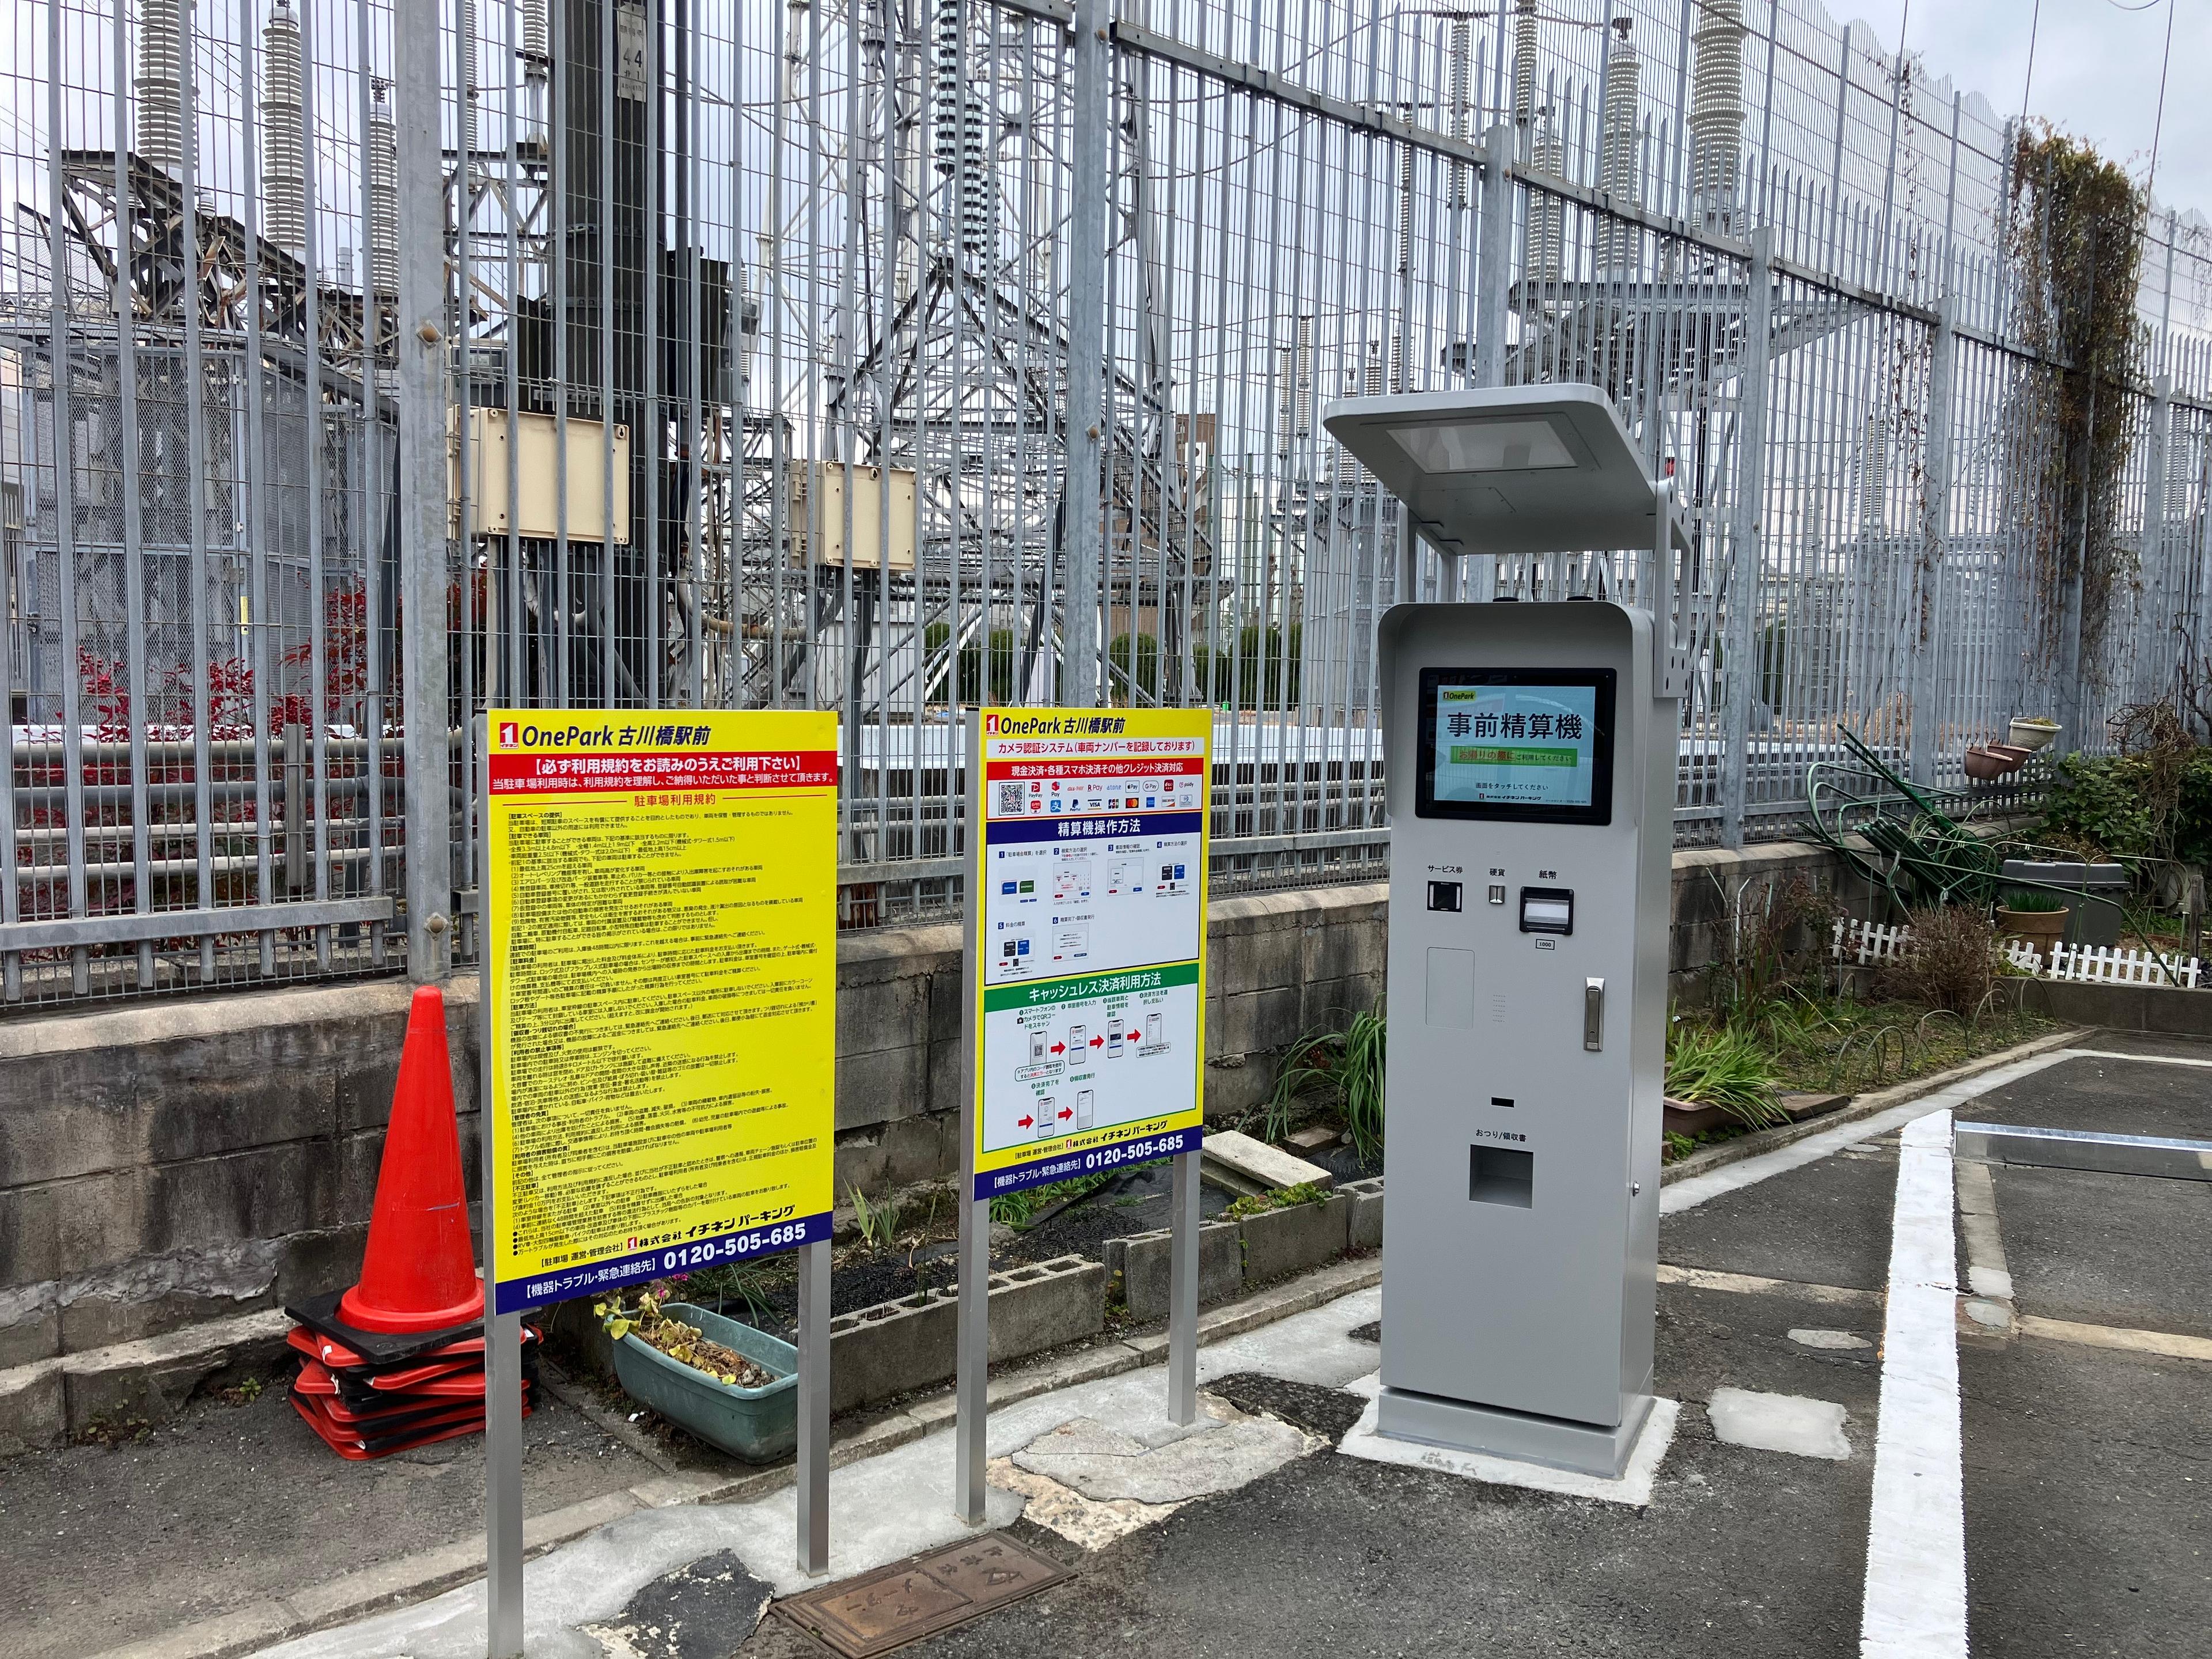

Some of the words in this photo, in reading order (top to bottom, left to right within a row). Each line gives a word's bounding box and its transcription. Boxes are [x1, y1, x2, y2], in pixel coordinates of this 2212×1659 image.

[1001, 717, 1060, 734] OnePark
[1063, 717, 1126, 734] 古川橋駅前
[1447, 712, 1582, 740] 事前精算機
[522, 725, 615, 747] OnePark
[618, 725, 711, 747] 古川橋駅前
[998, 740, 1195, 755] カメラ認証システム(車両ナンバーを記録しております)
[535, 756, 802, 775] 【必ず利用規約をお読みのうえご利用下さい】
[1011, 762, 1184, 777] 現金決済・各種スマホ決済その他クレジット決済対応
[1476, 782, 1549, 791] 画面をタッチしてください
[634, 793, 716, 807] 駐車場利用規約
[1058, 819, 1141, 836] 精算機操作方法
[1427, 865, 1463, 874] サービス券
[1489, 868, 1505, 877] 硬貨
[1539, 870, 1557, 880] 紙幣
[509, 943, 536, 952] 【駐車時間】
[509, 956, 536, 965] 【駐車料金】
[1029, 972, 1161, 1002] キャッシュレス決済利用方法
[510, 1001, 537, 1010] 【駐車方法】
[1073, 1137, 1098, 1147] 株式会社
[1100, 1128, 1131, 1142] イチネン
[1132, 1120, 1168, 1135] パーキング
[1476, 1128, 1527, 1142] おつり/領収書
[994, 1158, 1081, 1189] 【機器トラブル・緊急連絡先】
[1086, 1135, 1183, 1169] 0120-505-685
[512, 1169, 533, 1179] 【その他】
[512, 1181, 539, 1192] 【不正駐車】
[639, 1232, 682, 1248] 株式会社
[685, 1218, 736, 1237] イチネン
[738, 1205, 796, 1229] パーキング
[527, 1259, 657, 1299] 【機器トラブル・緊急連絡先】
[664, 1223, 806, 1270] 0120-505-685
